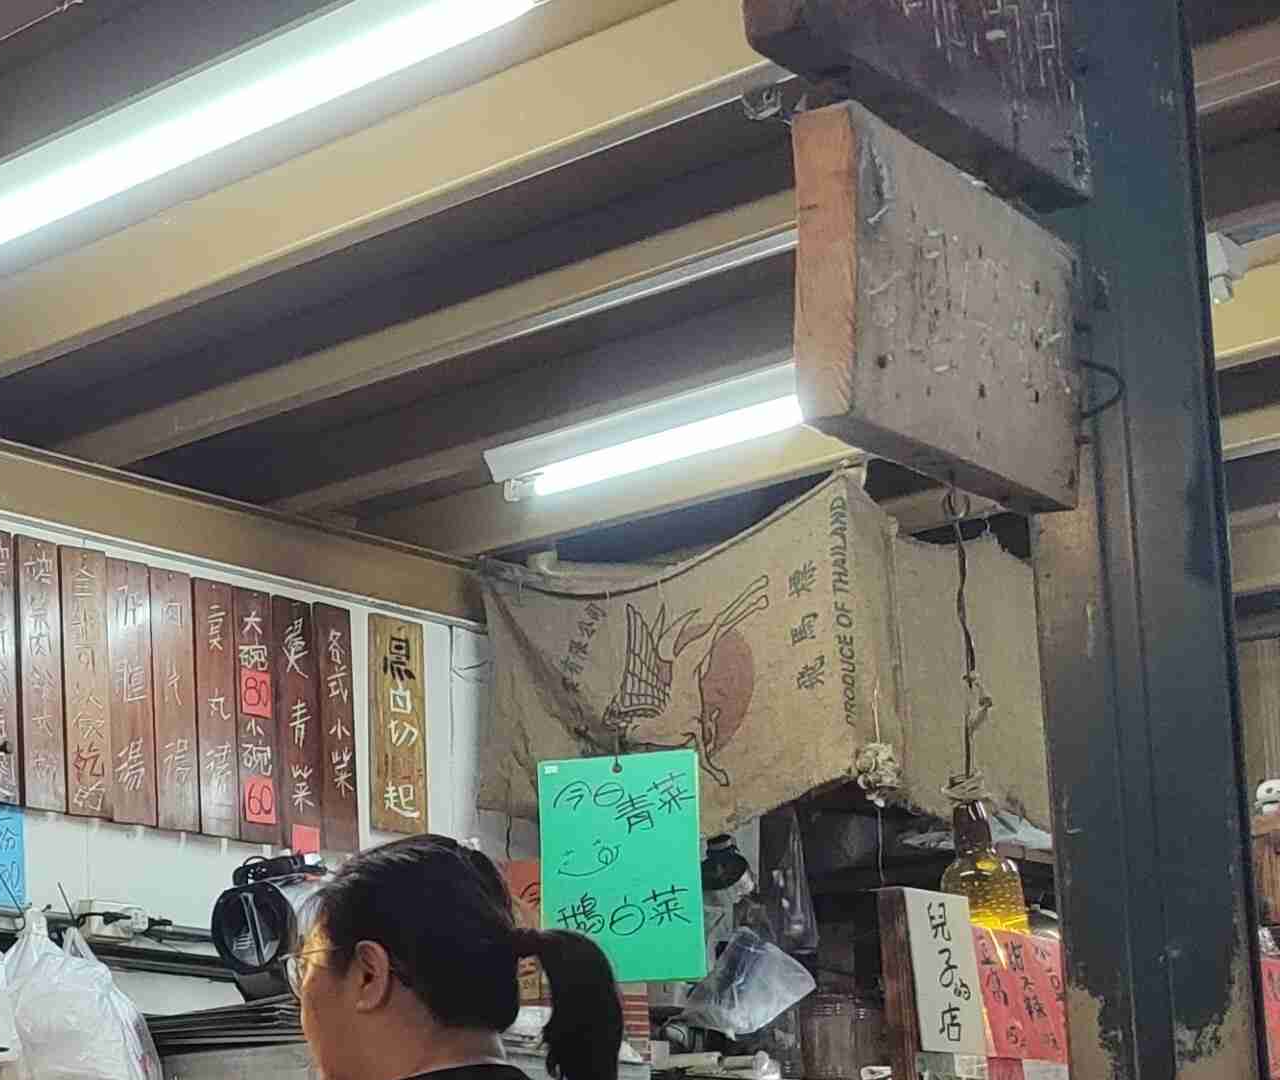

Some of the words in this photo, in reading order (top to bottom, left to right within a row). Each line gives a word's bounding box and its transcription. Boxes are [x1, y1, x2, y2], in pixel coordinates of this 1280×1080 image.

[830, 496, 852, 599] THAILAND
[833, 604, 853, 629] OF
[928, 902, 971, 1042] 兒子的店
